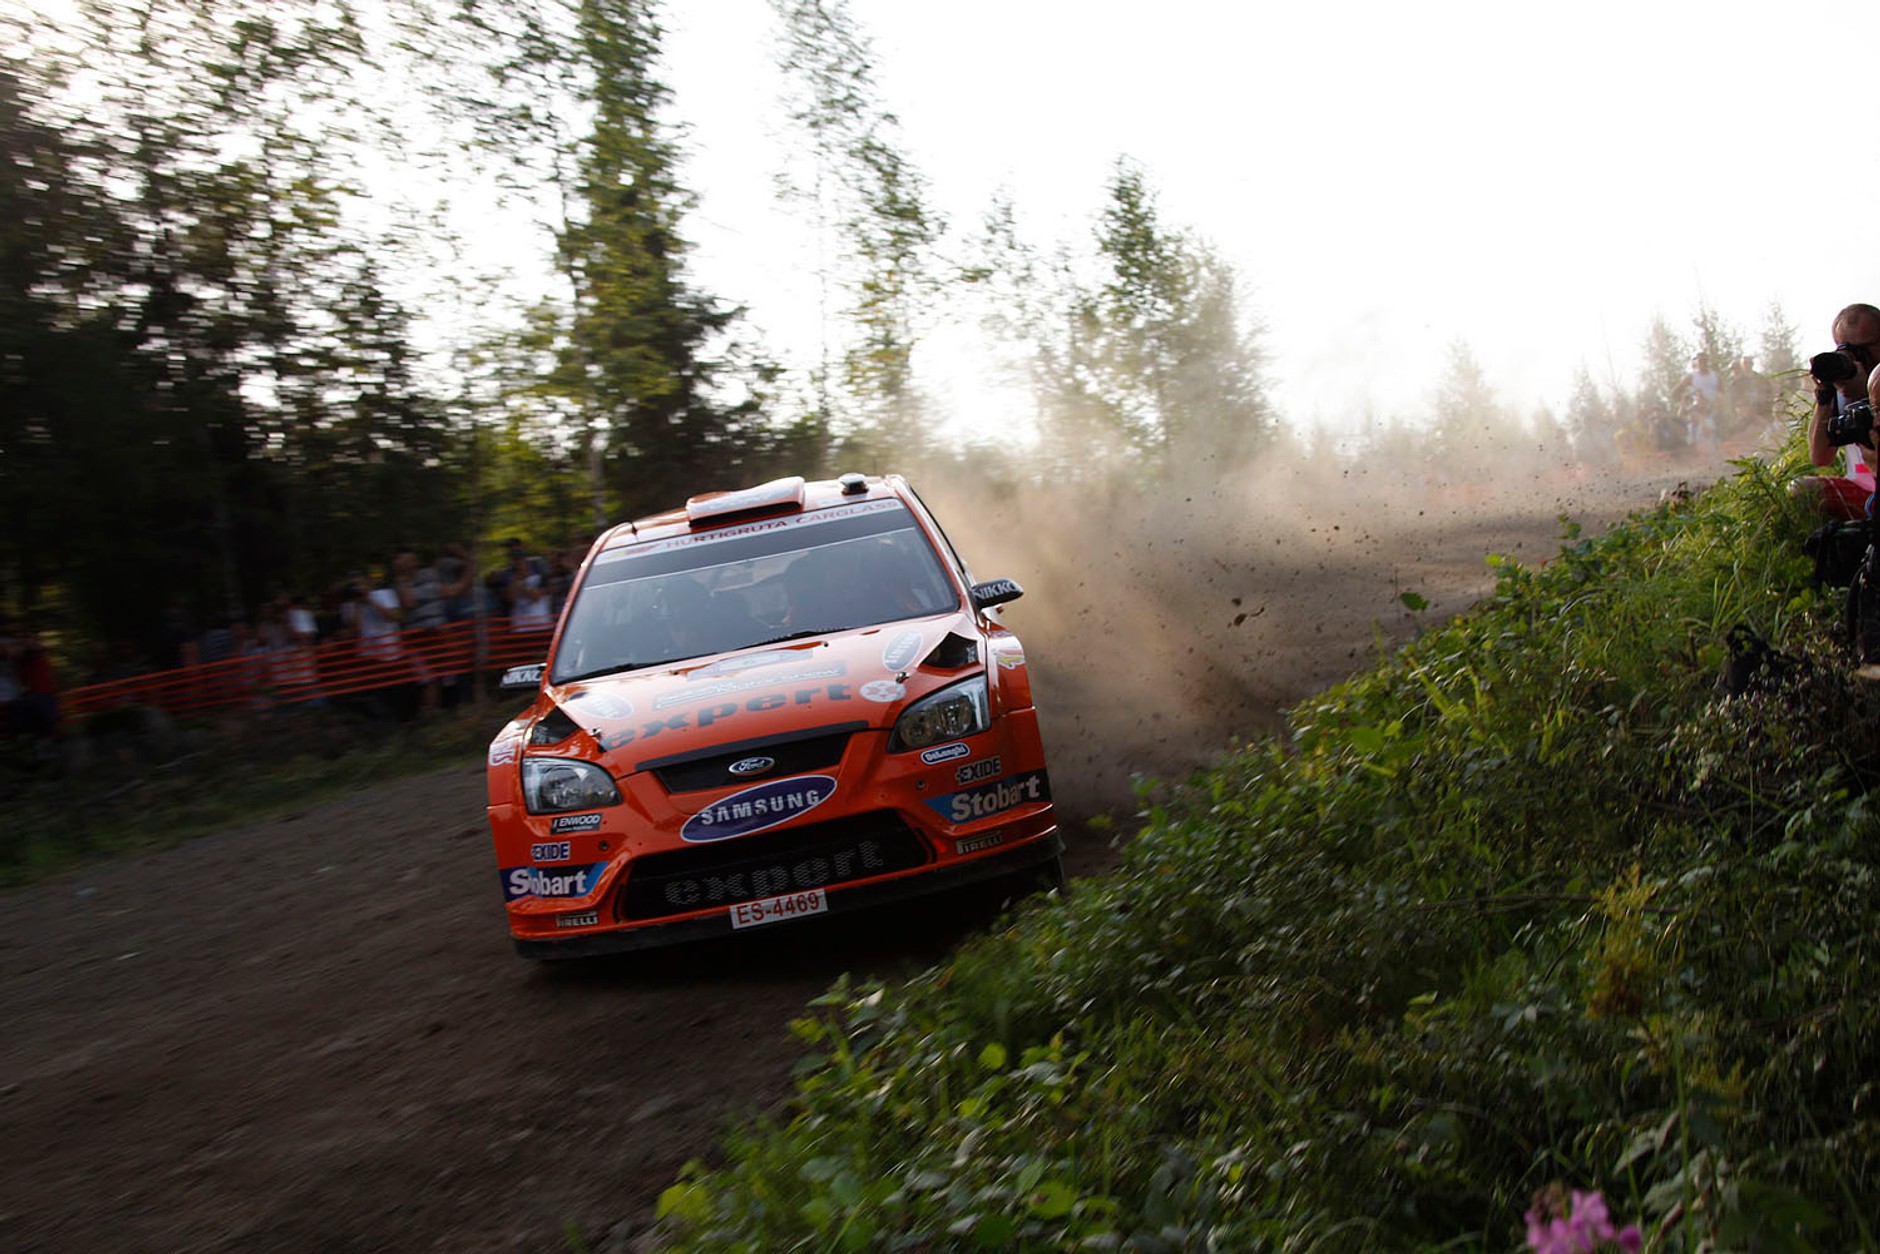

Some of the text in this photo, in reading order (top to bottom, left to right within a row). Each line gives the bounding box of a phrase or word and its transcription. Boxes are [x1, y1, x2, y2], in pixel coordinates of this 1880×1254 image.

[666, 500, 899, 549] HURTIGRUTA CARGLASS
[607, 683, 852, 750] expert
[737, 757, 766, 771] Ford
[955, 757, 1001, 784] EXIDE
[701, 789, 821, 826] SAMSUNG
[951, 775, 1040, 821] Stobart
[532, 842, 570, 861] EXIDE
[664, 840, 884, 906] expert
[737, 892, 821, 925] ES-4469
